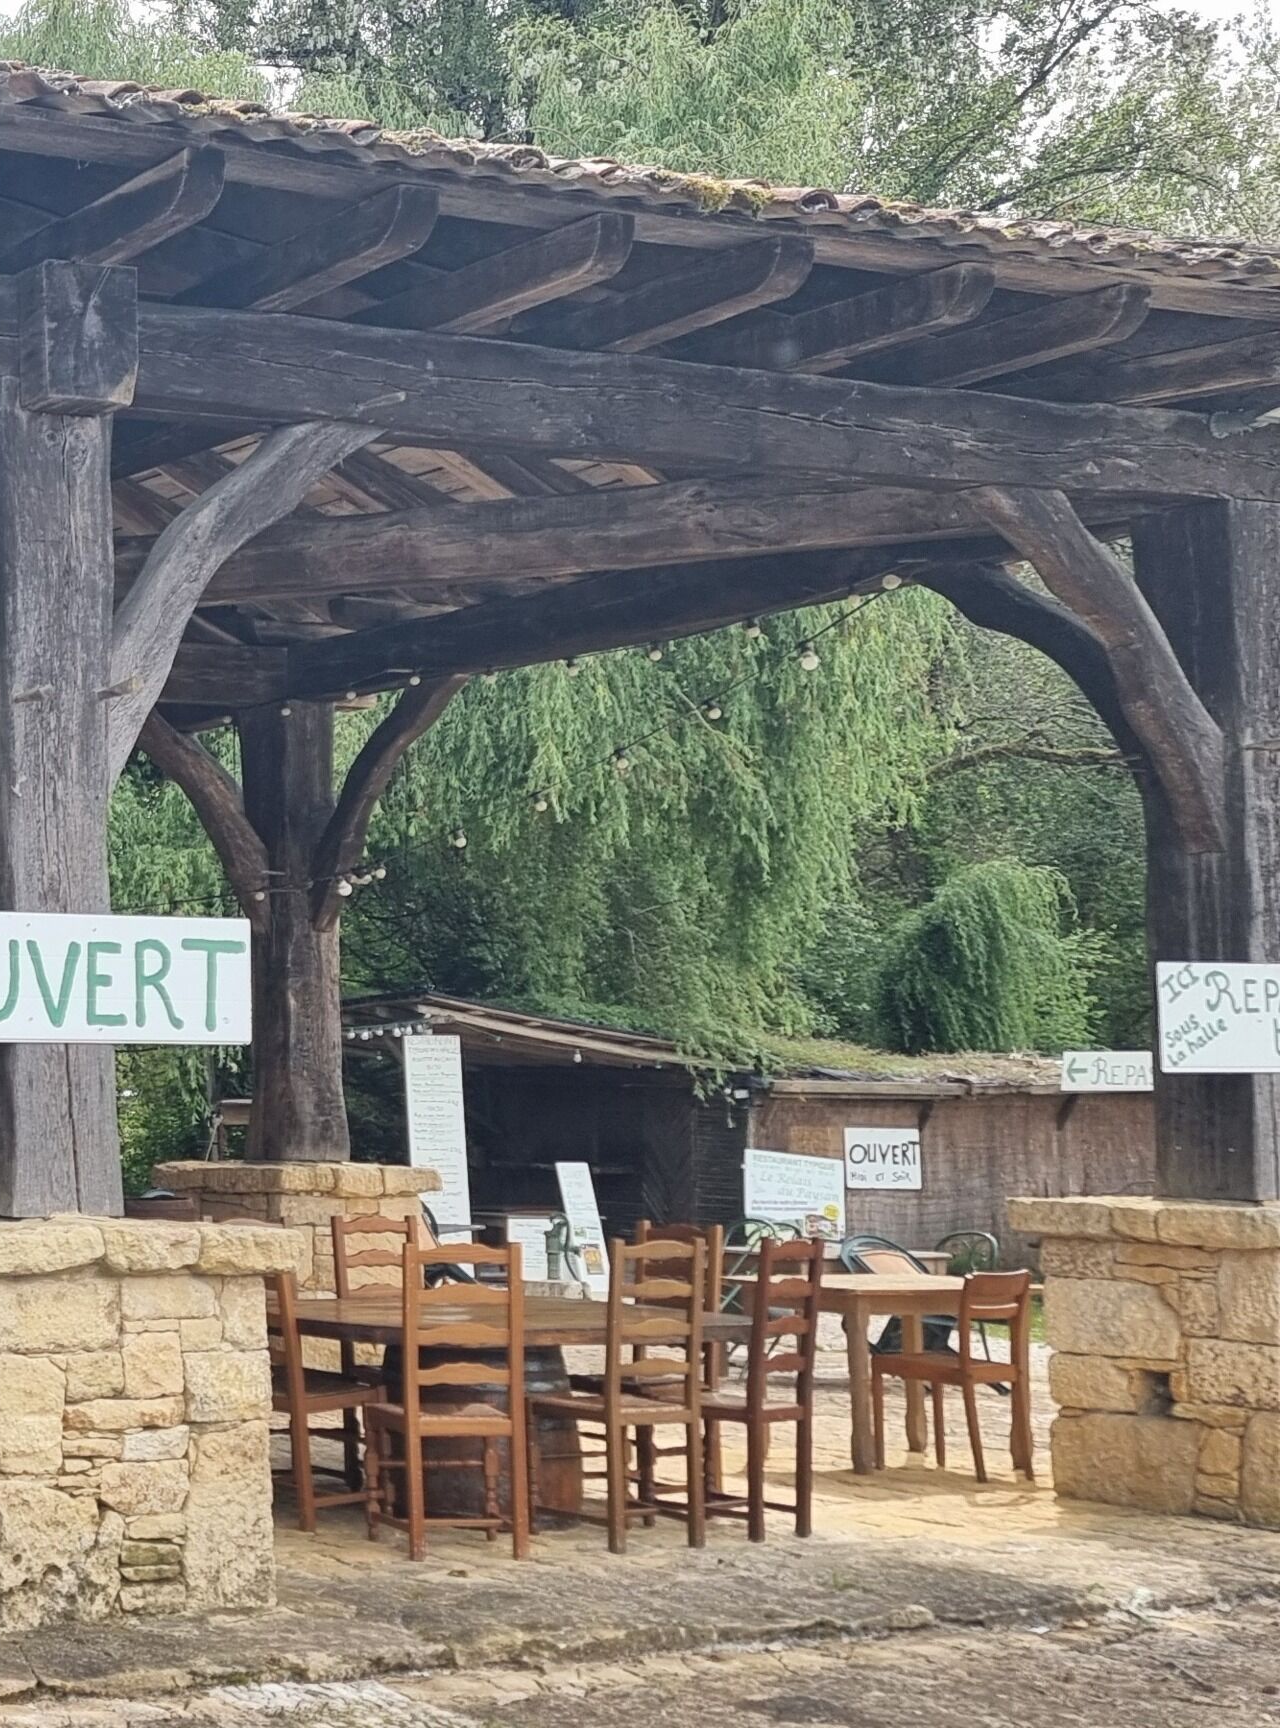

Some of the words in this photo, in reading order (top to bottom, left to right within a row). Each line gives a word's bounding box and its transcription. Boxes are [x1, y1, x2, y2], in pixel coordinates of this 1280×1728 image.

[1161, 964, 1200, 1004] ICI
[1204, 971, 1280, 1014] REP
[1185, 1018, 1228, 1054] halle
[849, 1141, 920, 1166] OUVERT
